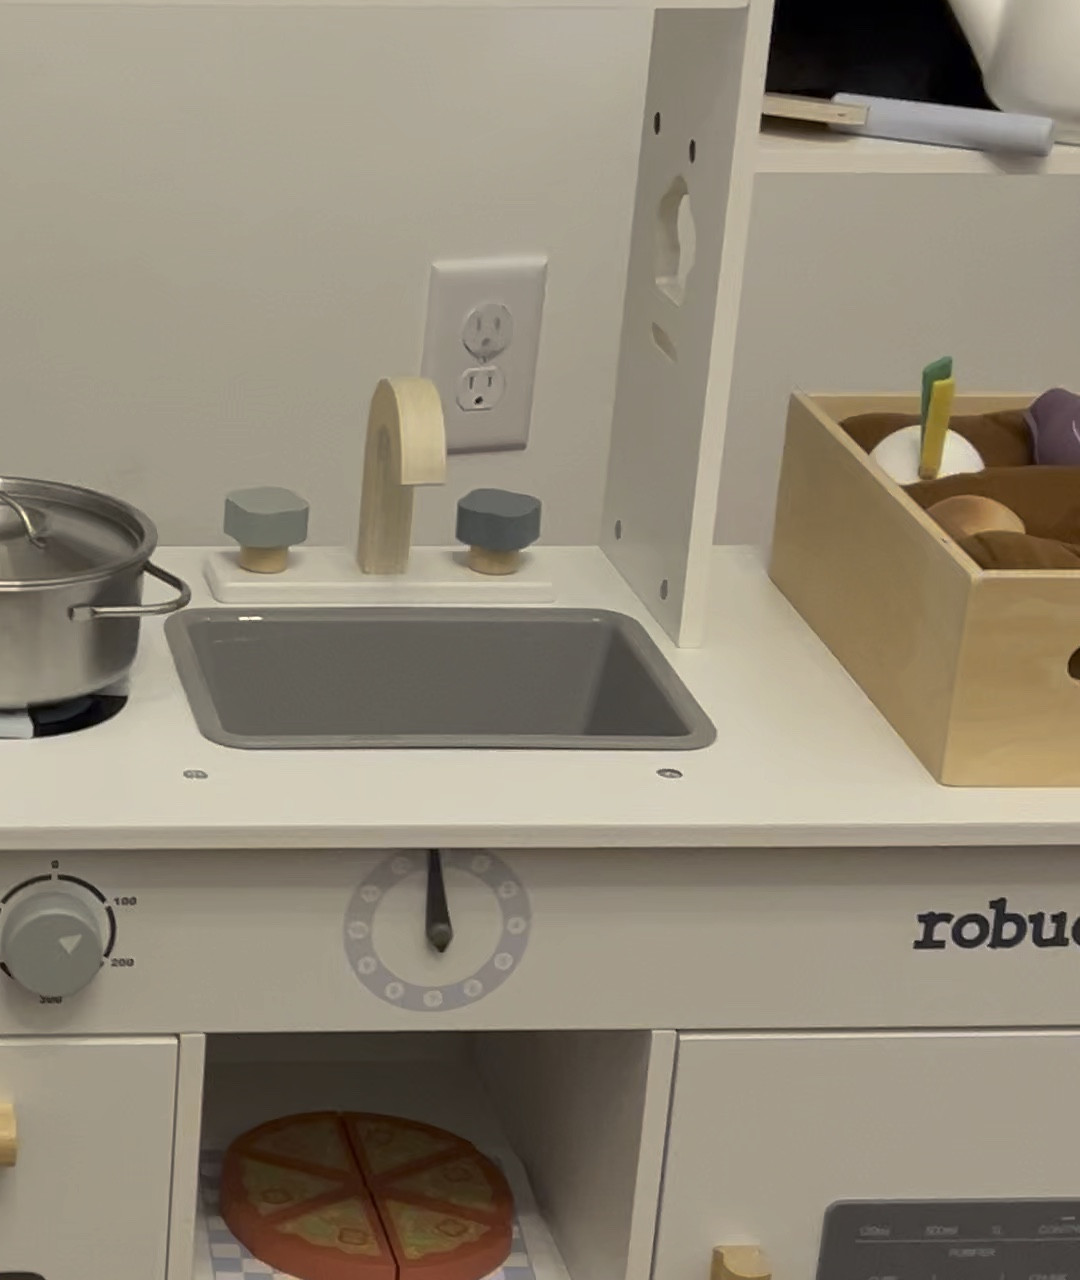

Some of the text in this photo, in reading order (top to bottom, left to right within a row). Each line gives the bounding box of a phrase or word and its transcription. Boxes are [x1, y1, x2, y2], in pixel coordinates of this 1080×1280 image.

[113, 896, 137, 906] 100
[913, 897, 1080, 950] robu
[111, 958, 135, 968] 200
